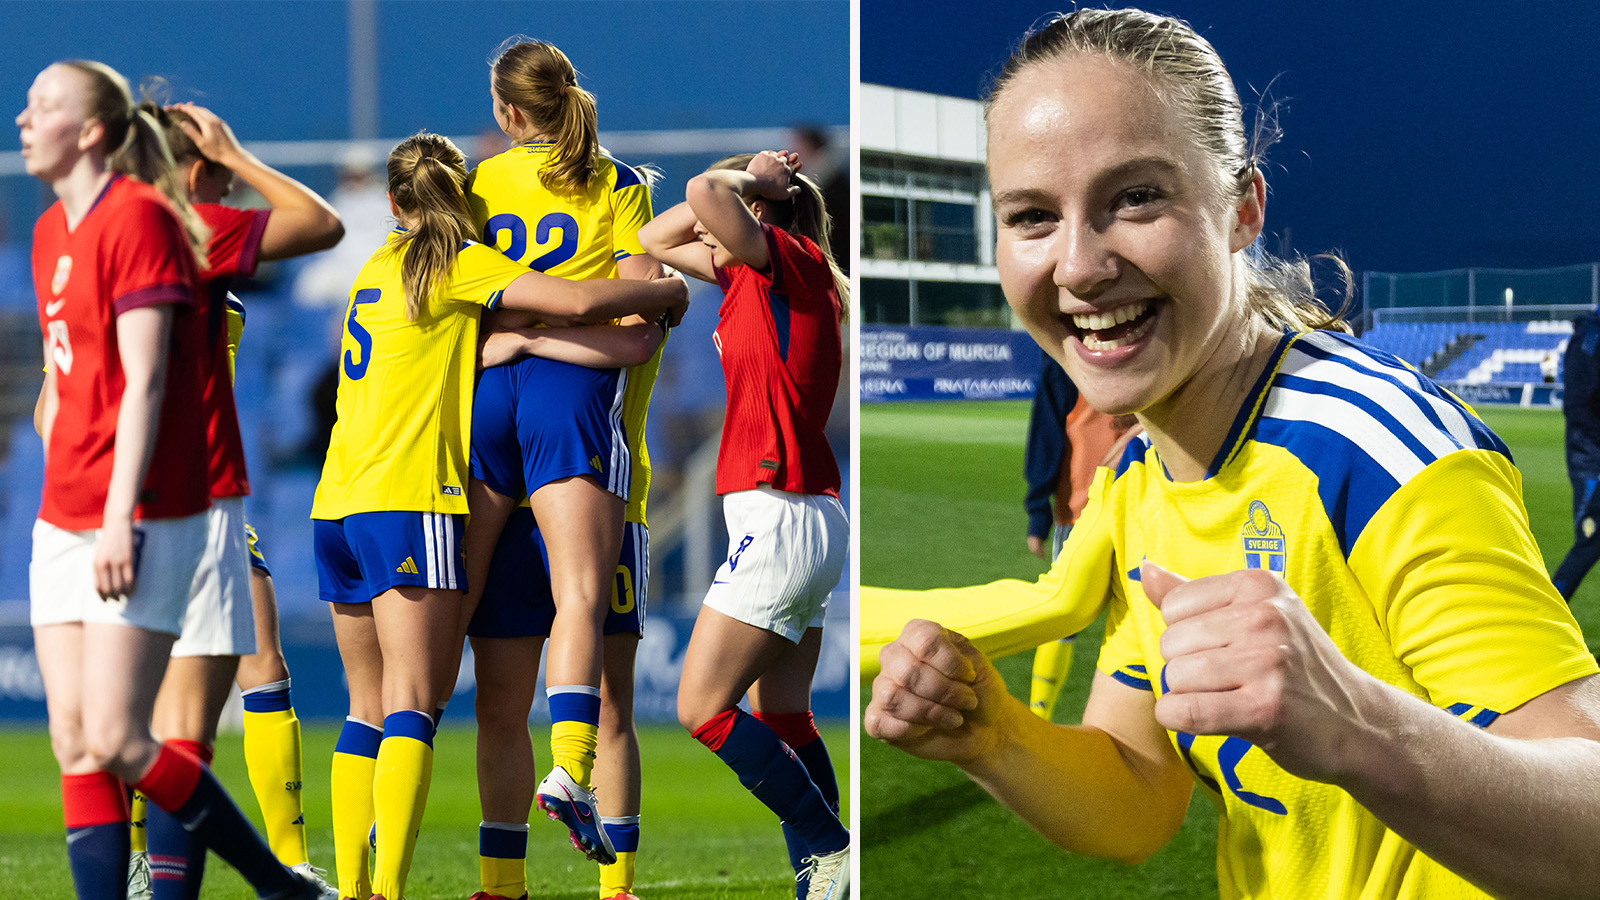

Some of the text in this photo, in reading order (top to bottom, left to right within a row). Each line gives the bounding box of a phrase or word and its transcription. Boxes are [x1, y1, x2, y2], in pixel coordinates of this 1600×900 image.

[339, 288, 382, 381] 5
[923, 342, 946, 361] OF
[949, 343, 1012, 361] MURCIA
[1248, 540, 1279, 550] SVERIGE
